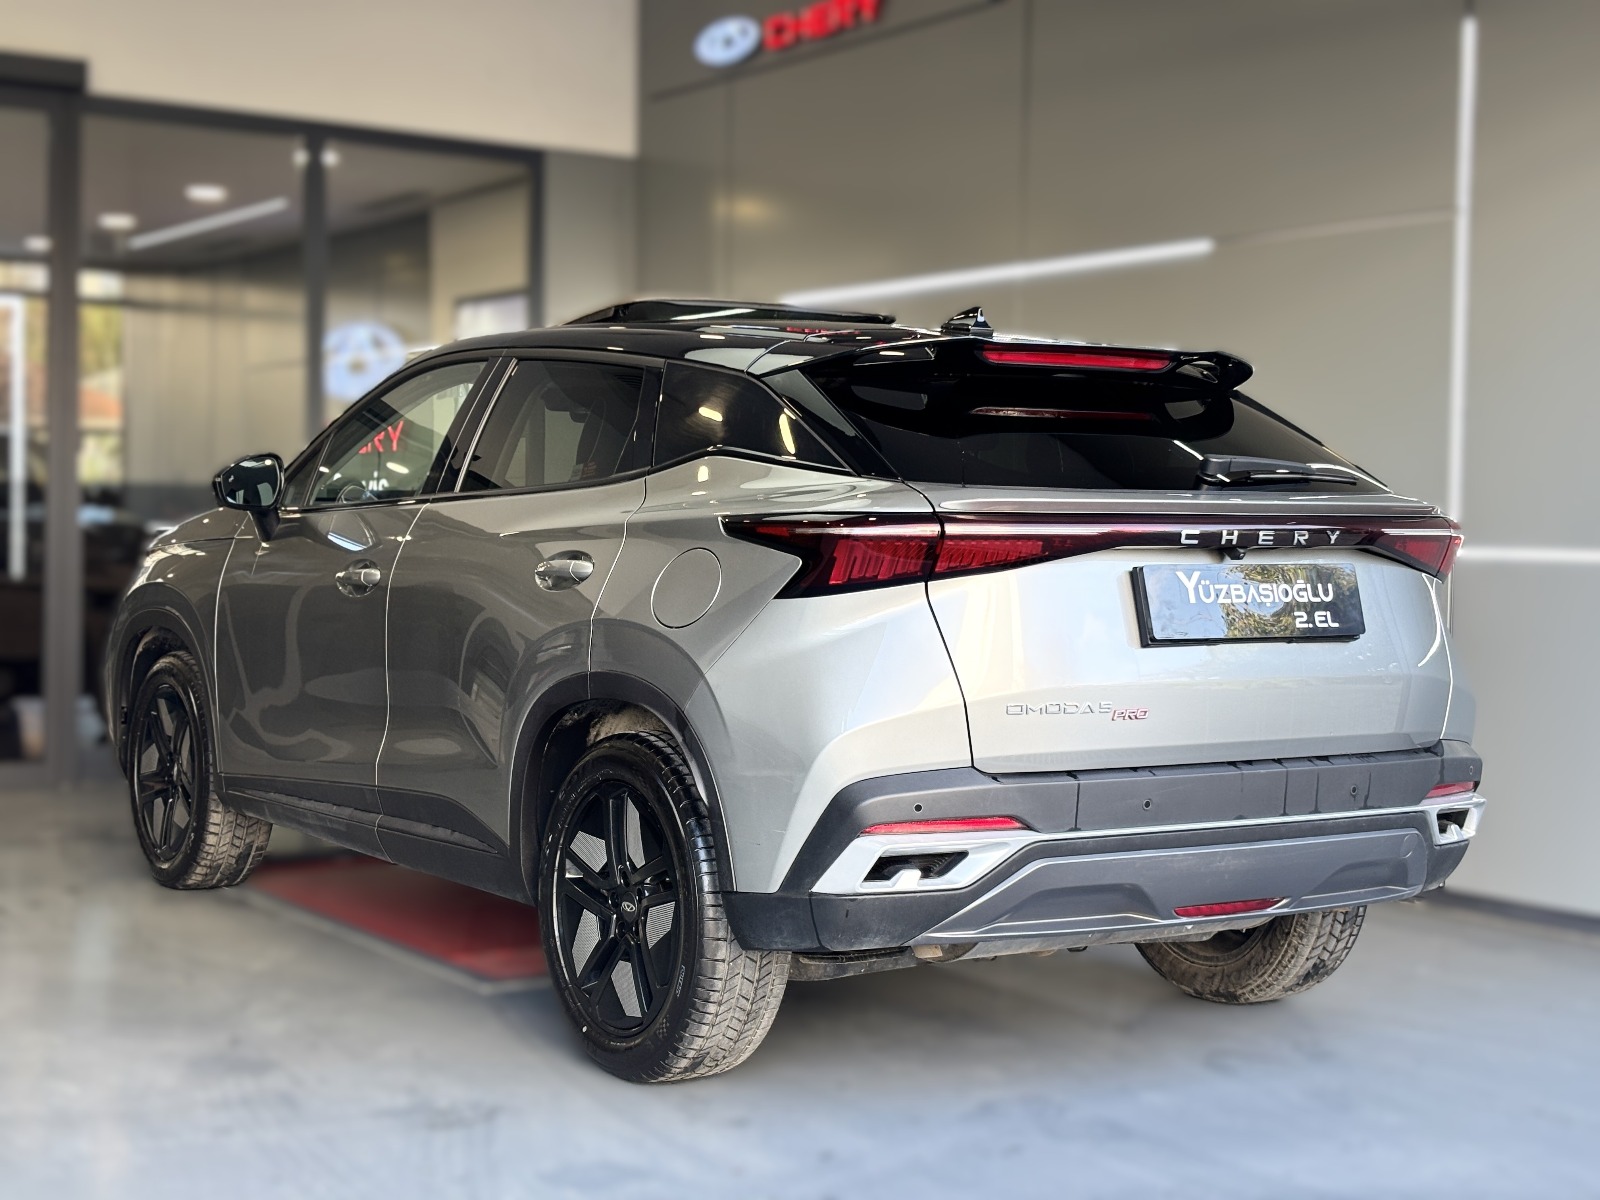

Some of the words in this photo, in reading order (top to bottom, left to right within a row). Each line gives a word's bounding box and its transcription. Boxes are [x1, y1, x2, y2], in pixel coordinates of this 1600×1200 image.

[1180, 529, 1342, 545] CHERY
[1175, 570, 1334, 607] YÜZBAŞIOĞLU
[1111, 708, 1149, 721] PRO
